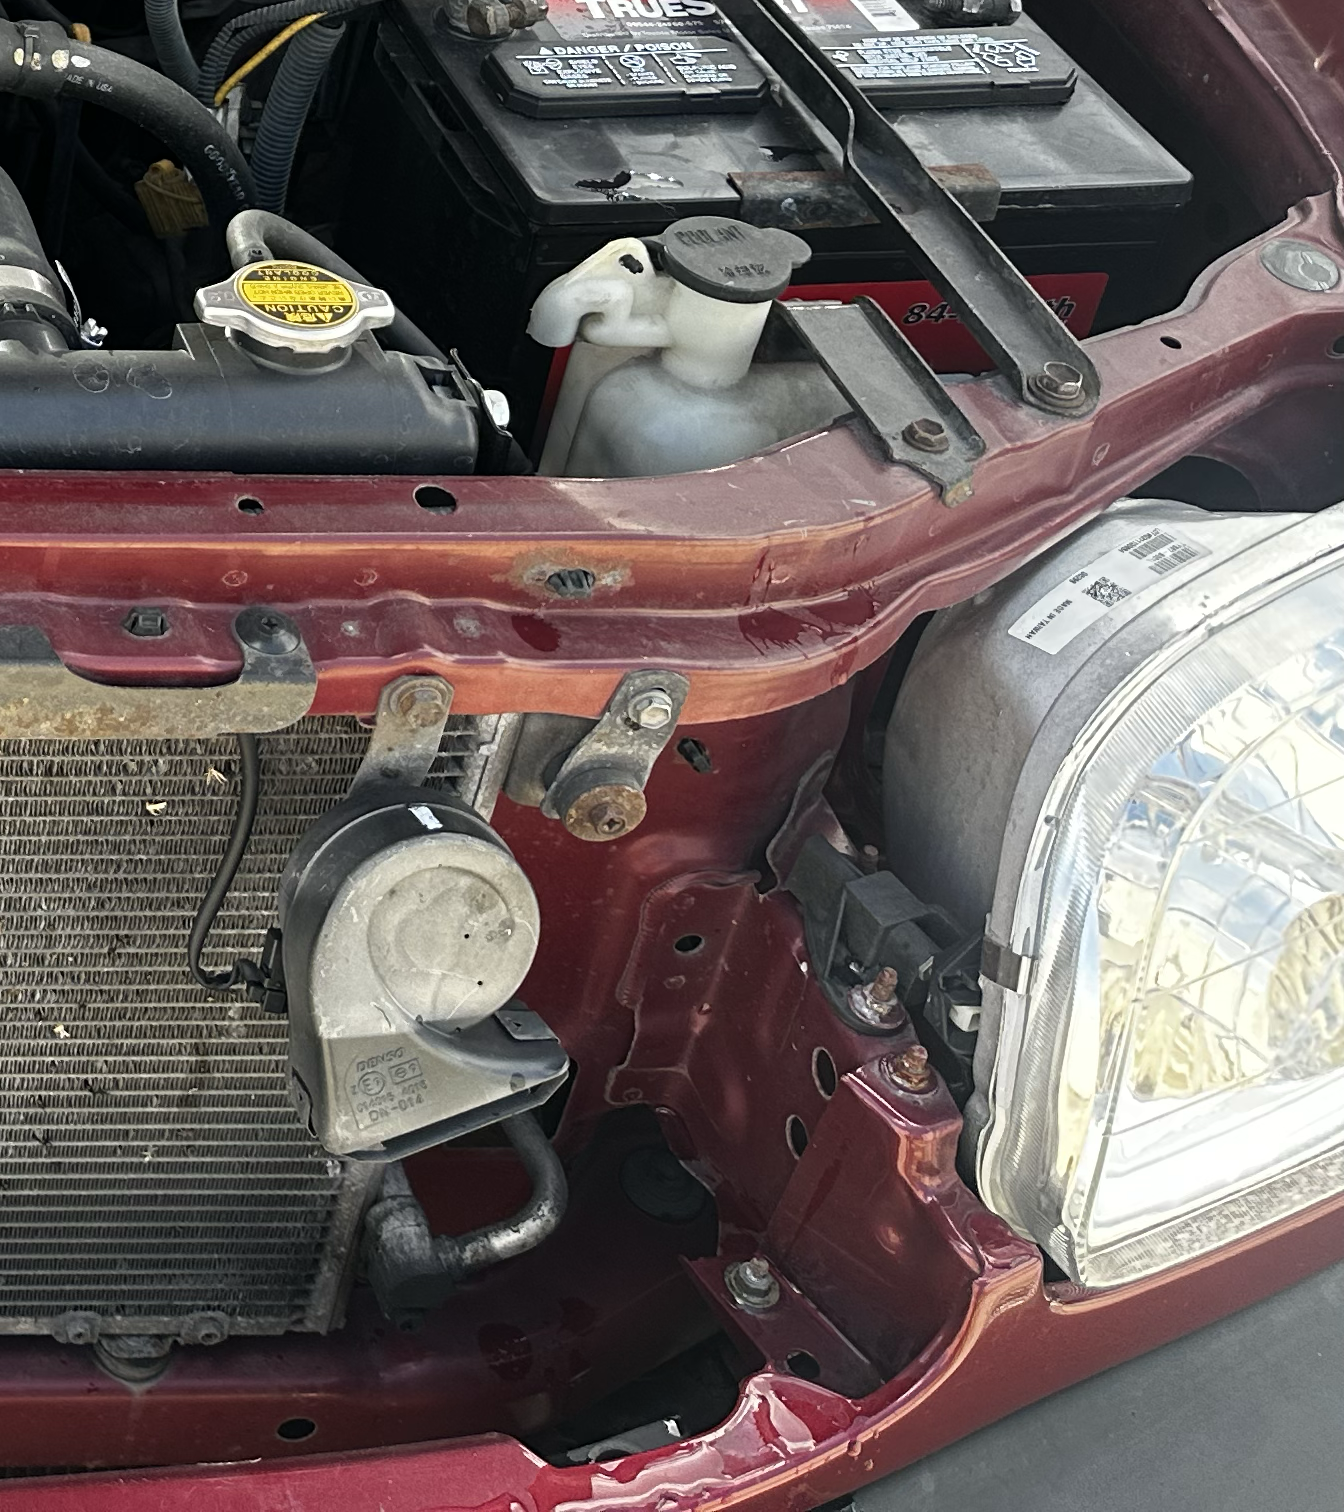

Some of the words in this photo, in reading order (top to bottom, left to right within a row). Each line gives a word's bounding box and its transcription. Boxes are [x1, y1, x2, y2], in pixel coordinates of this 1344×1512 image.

[554, 44, 620, 56] DANGER
[633, 42, 694, 52] POISON
[264, 304, 344, 314] CAUTION
[1054, 599, 1074, 615] MADE
[1047, 611, 1058, 620] IN
[1024, 619, 1051, 640] TAIWAN
[356, 1046, 405, 1072] DENSO
